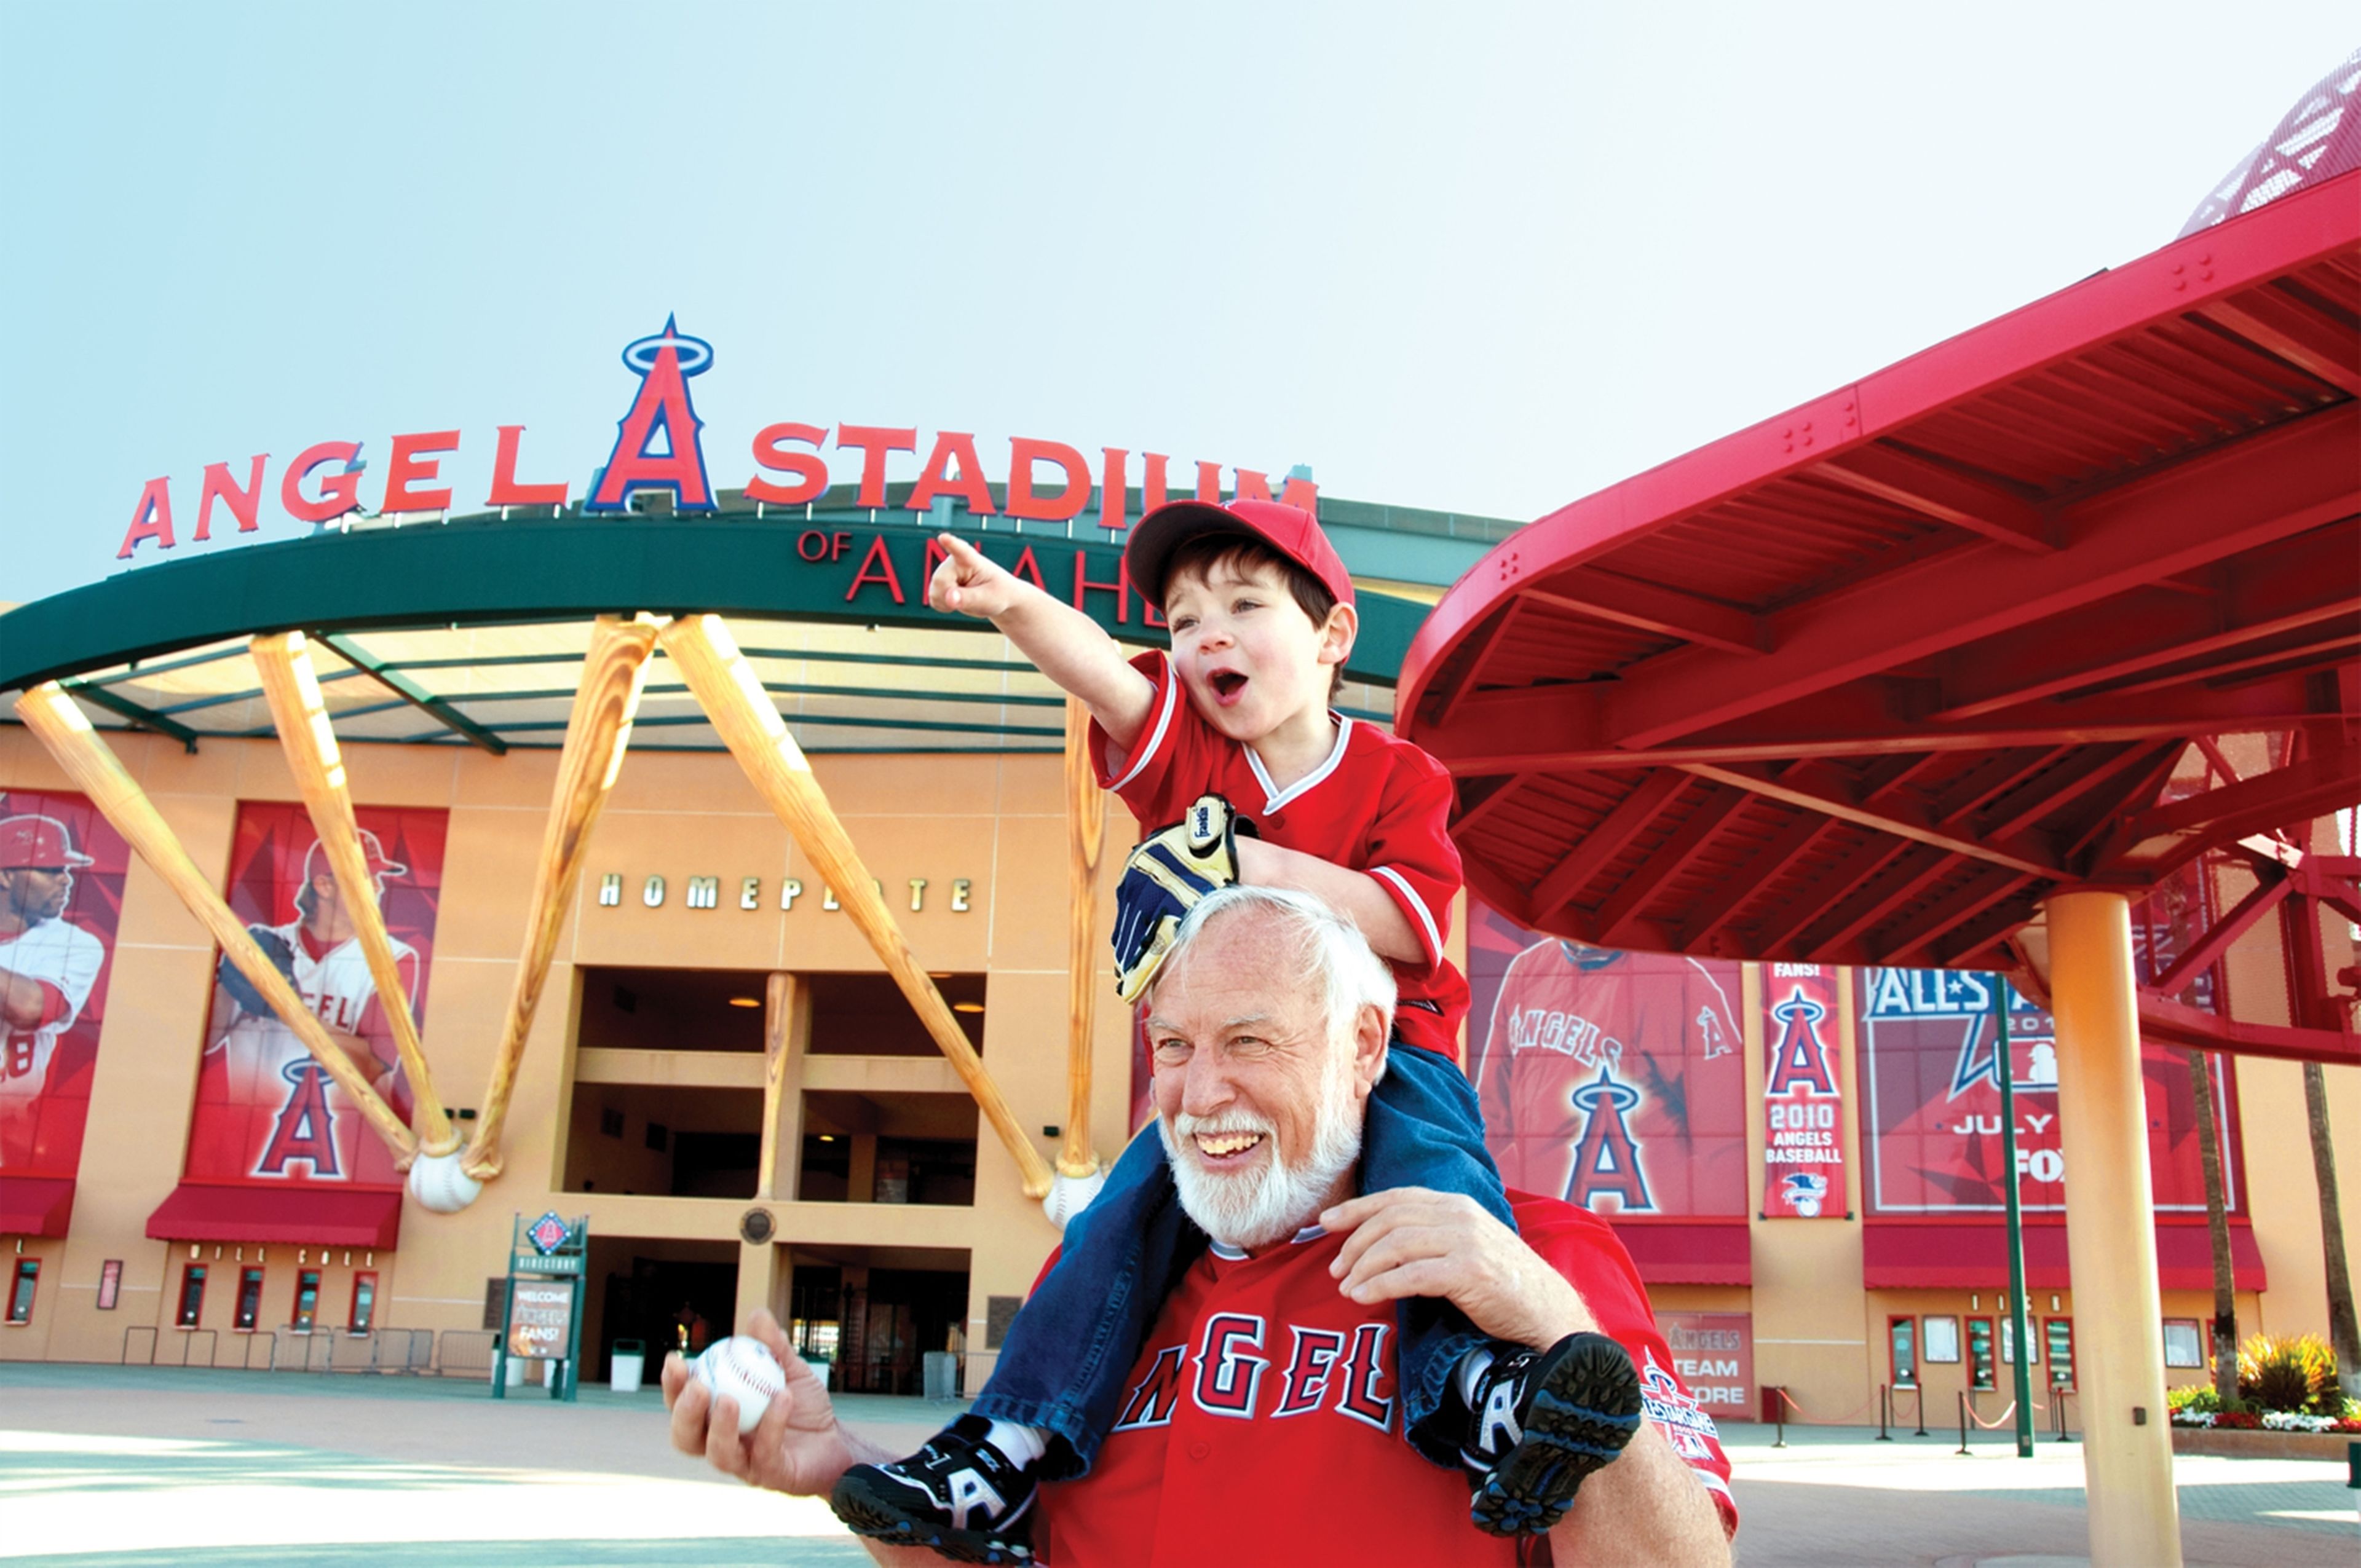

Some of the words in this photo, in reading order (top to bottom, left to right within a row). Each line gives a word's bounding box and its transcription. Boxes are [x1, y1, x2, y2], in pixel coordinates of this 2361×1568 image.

[116, 425, 569, 559] ANGEL
[797, 530, 852, 562] OF
[1770, 1104, 1835, 1130] 2010
[1773, 1131, 1833, 1146] ANGELS
[1766, 1148, 1843, 1164] BASEBALL
[2015, 1148, 2065, 1183] FO
[516, 1290, 568, 1303] WELCOME
[1669, 1322, 1741, 1350] ANGELS
[1674, 1359, 1739, 1377] TEAM
[1691, 1386, 1745, 1405] ORE
